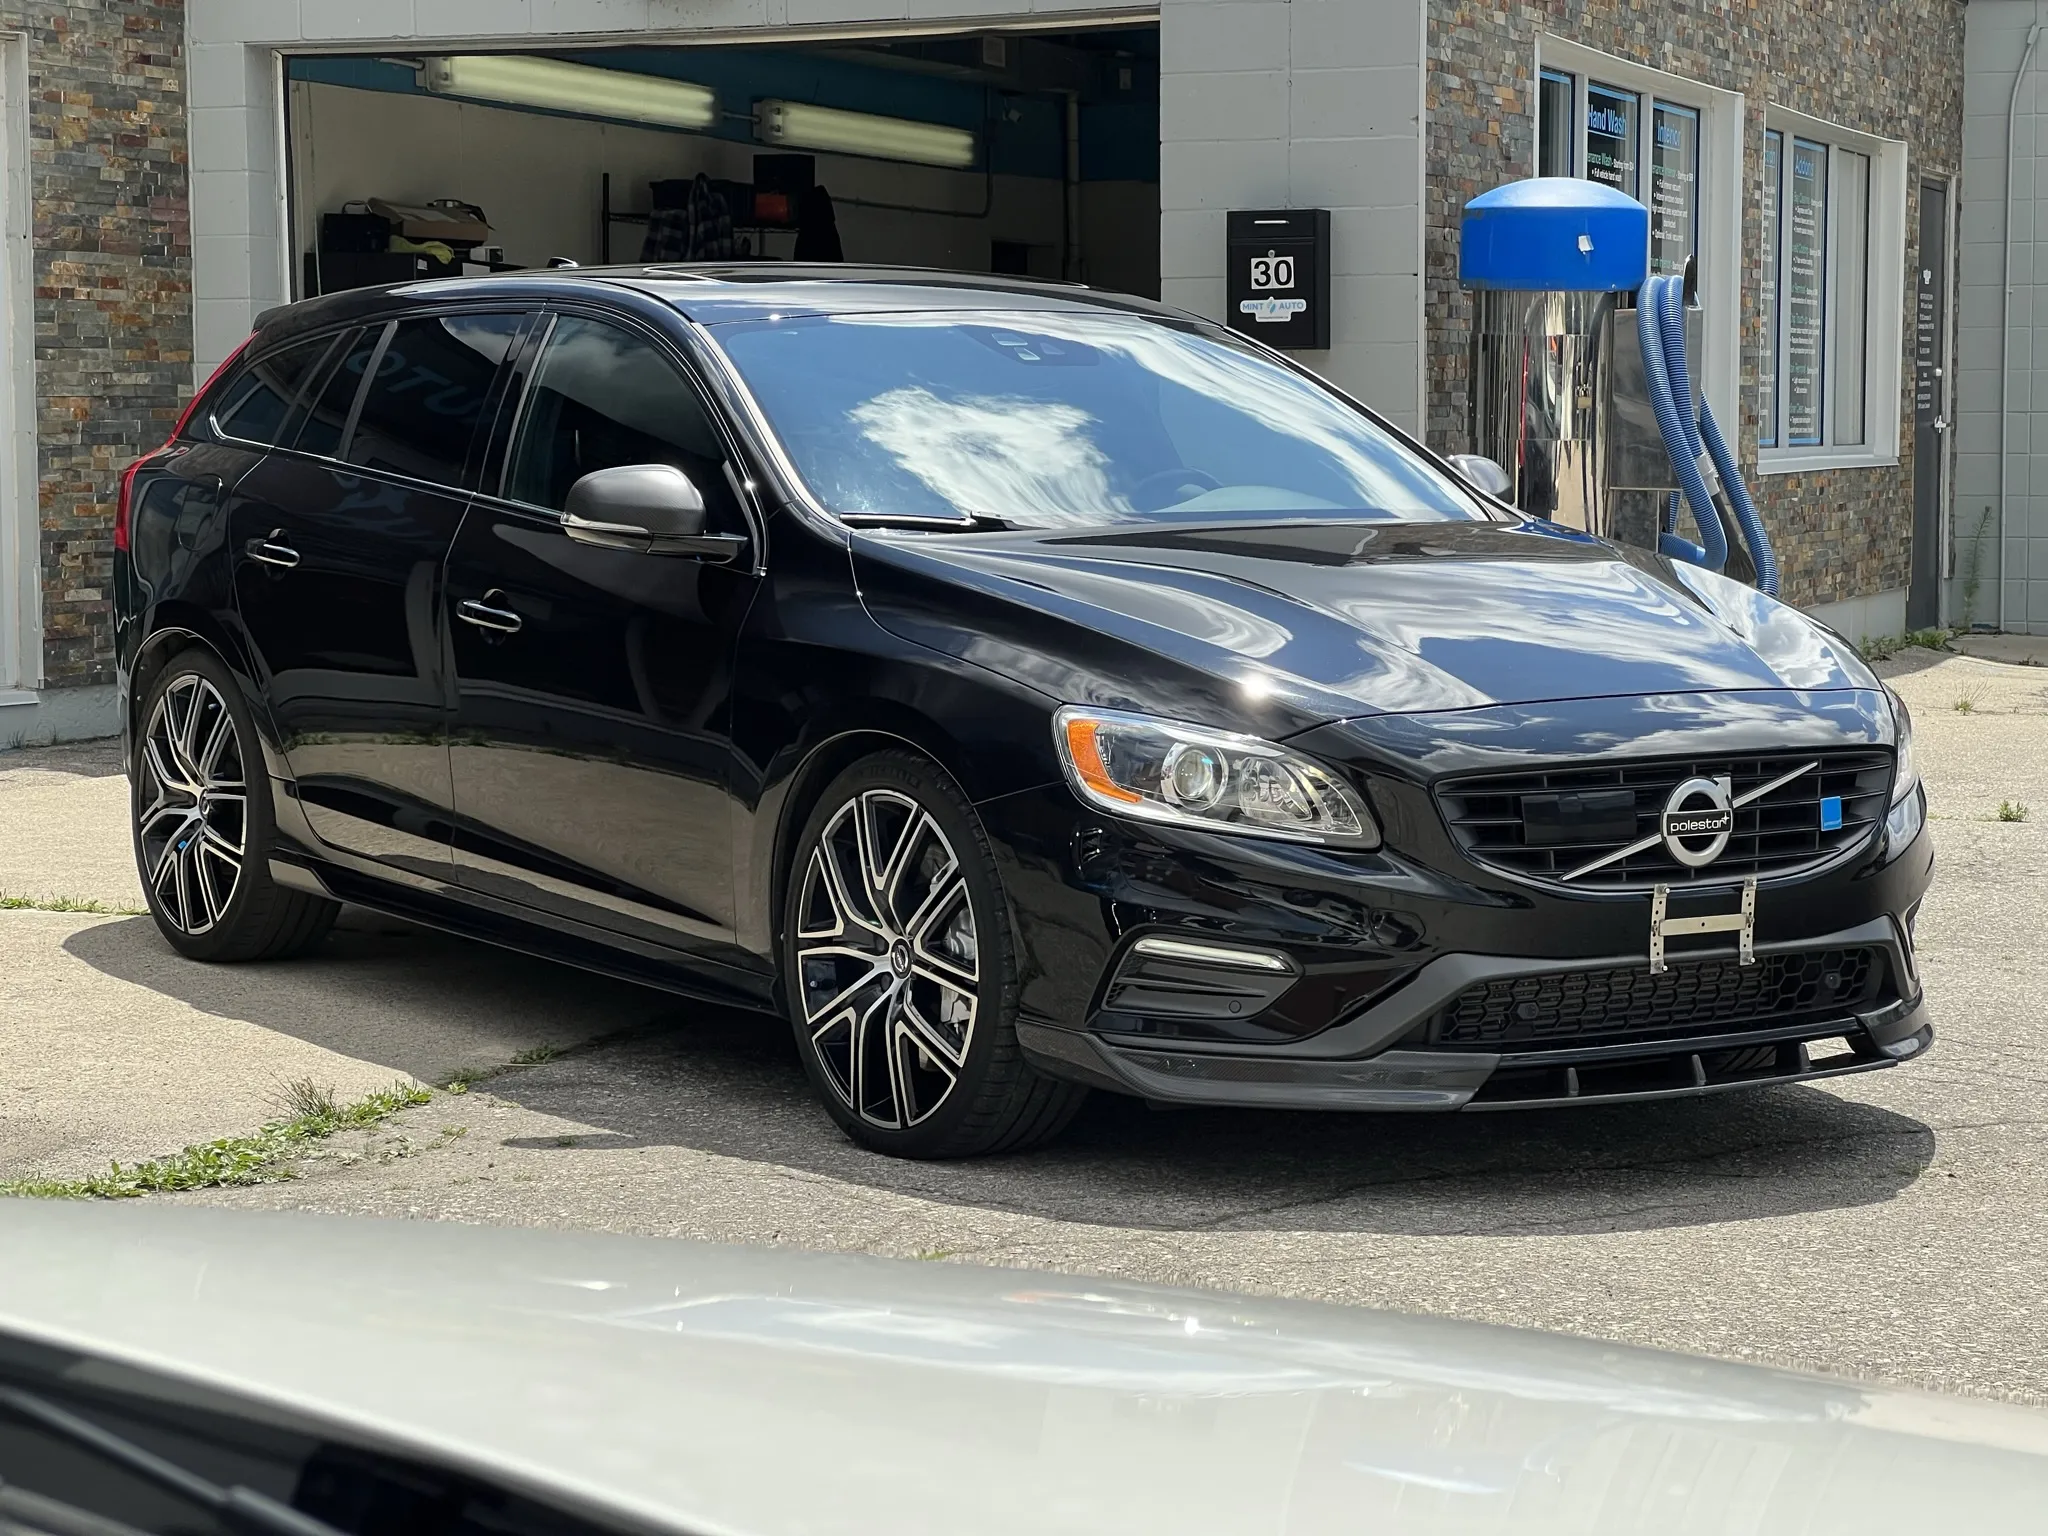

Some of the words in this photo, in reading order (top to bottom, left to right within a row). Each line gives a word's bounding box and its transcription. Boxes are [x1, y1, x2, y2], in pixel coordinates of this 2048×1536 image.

[1588, 104, 1607, 131] Hand
[1607, 109, 1627, 136] Wash
[1657, 119, 1681, 147] Interior
[1254, 260, 1292, 287] 30
[1242, 302, 1264, 311] MINT
[1279, 302, 1304, 311] AUTO
[1670, 817, 1727, 834] polestar
